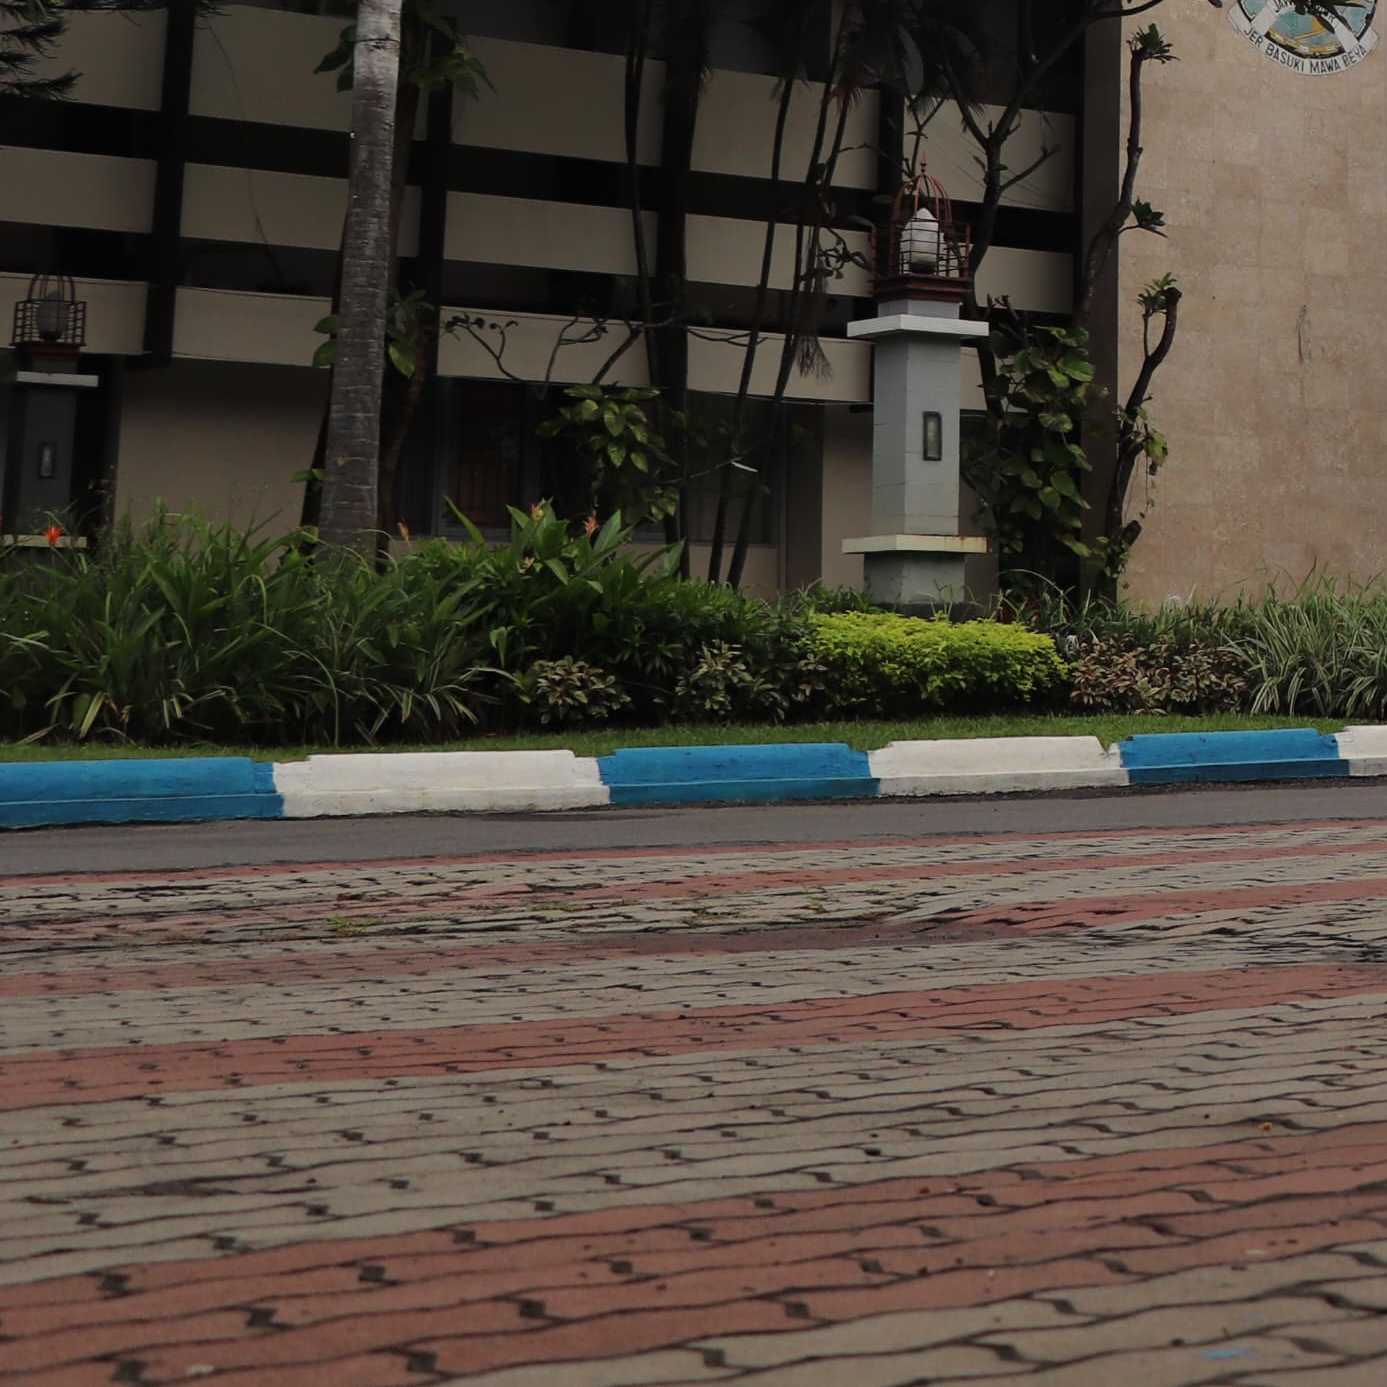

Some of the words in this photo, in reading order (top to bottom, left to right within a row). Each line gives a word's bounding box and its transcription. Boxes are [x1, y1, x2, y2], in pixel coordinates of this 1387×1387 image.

[1243, 27, 1264, 47] JER
[1265, 43, 1305, 72] BASUKI
[1310, 58, 1341, 73] MAWA
[1342, 44, 1368, 67] BEYA
